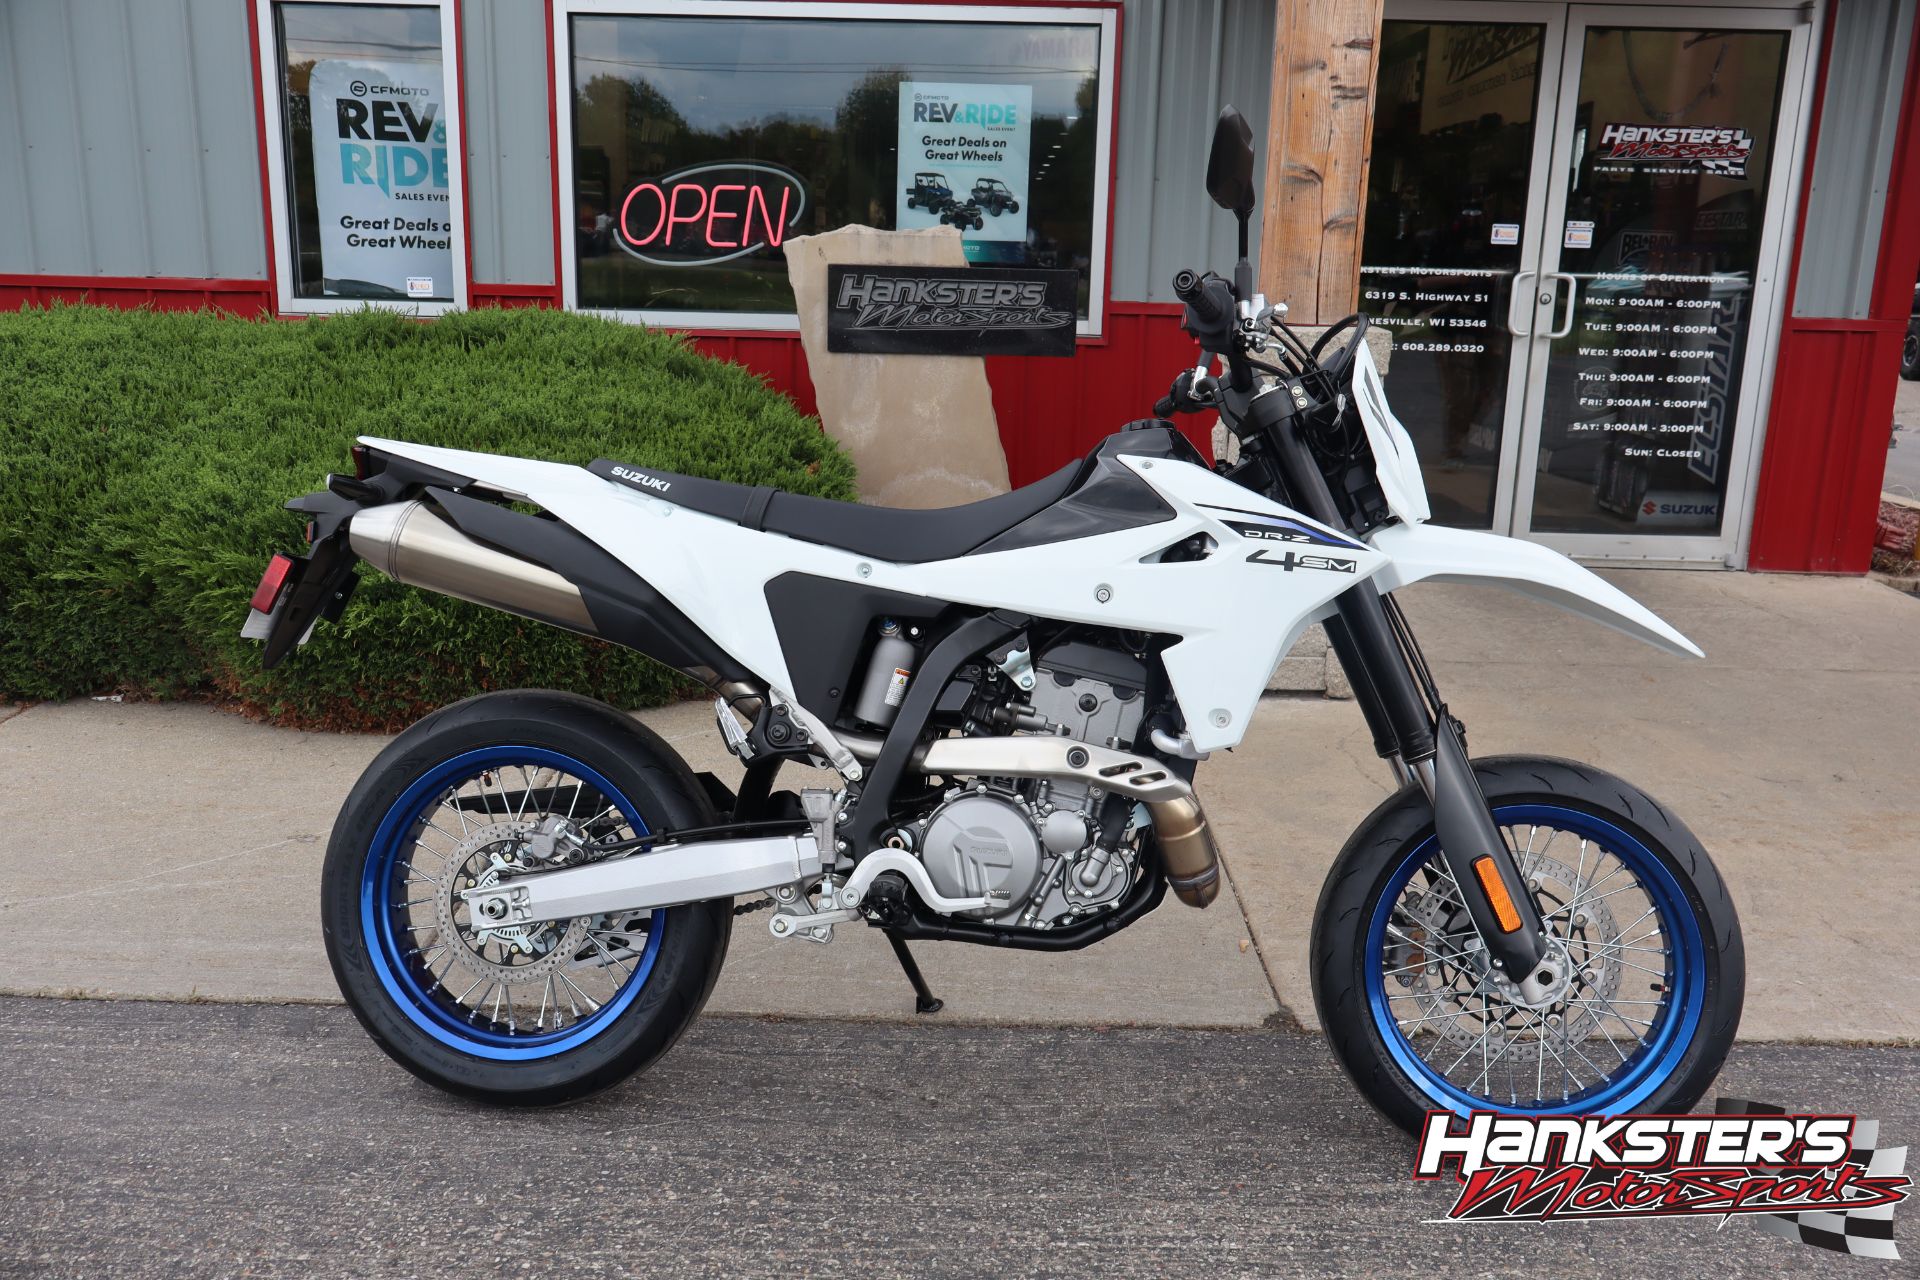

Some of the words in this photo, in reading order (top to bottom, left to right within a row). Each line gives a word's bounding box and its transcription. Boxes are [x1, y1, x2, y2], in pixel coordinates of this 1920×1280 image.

[370, 85, 430, 97] CFMOTO
[922, 135, 956, 147] Great
[958, 136, 990, 148] Deals
[993, 139, 1007, 149] on
[925, 149, 959, 161] Great
[962, 150, 1004, 162] Wheels
[340, 143, 450, 199] RIDE
[395, 192, 425, 202] SALES
[427, 193, 450, 202] EVEN
[620, 183, 790, 248] OPEN
[340, 215, 391, 230] Great
[394, 216, 439, 232] Deals
[346, 233, 396, 248] Great
[400, 235, 451, 250] Wheel
[1360, 266, 1406, 275] KSTER'S
[1410, 266, 1493, 277] MOTORSPORTS
[1596, 271, 1637, 282] HOURS
[1640, 274, 1655, 282] OF
[1659, 273, 1725, 284] OPERATION
[1365, 291, 1396, 300] 6319
[1399, 292, 1411, 301] S.
[1416, 292, 1471, 302] HIGHWAY
[1474, 294, 1489, 303] 51
[1585, 297, 1615, 305] MON:
[1618, 298, 1665, 307] 9:00AM
[1676, 299, 1721, 309] 6:00PM
[1369, 317, 1425, 327] NESVILLE,
[1429, 318, 1445, 327] WI
[1449, 319, 1487, 328] 53546
[1585, 322, 1612, 331] TUE:
[1615, 323, 1661, 333] 9:00AM
[1672, 325, 1717, 334] 6:00PM
[1402, 343, 1485, 353] 608.289.0320
[1578, 348, 1608, 357] WED:
[1612, 348, 1658, 358] 9:00AM
[1669, 350, 1715, 359] 6:00PM
[1578, 373, 1606, 381] THU:
[1609, 374, 1654, 383] 9:00AM
[1666, 375, 1711, 384] 6:00PM
[1579, 398, 1602, 406] FRI:
[1606, 399, 1651, 407] 9:00AM
[1663, 400, 1708, 409] 6:00PM
[1573, 422, 1599, 431] SAT:
[1603, 423, 1648, 432] 9:00AM
[1659, 424, 1704, 433] 3:00PM
[1624, 448, 1653, 457] SUN:
[1656, 449, 1701, 458] CLOSED
[610, 466, 671, 492] SUZUKI
[1659, 504, 1717, 515] SUZUK
[1244, 529, 1311, 543] DR-Z
[1245, 549, 1357, 574] 4SM
